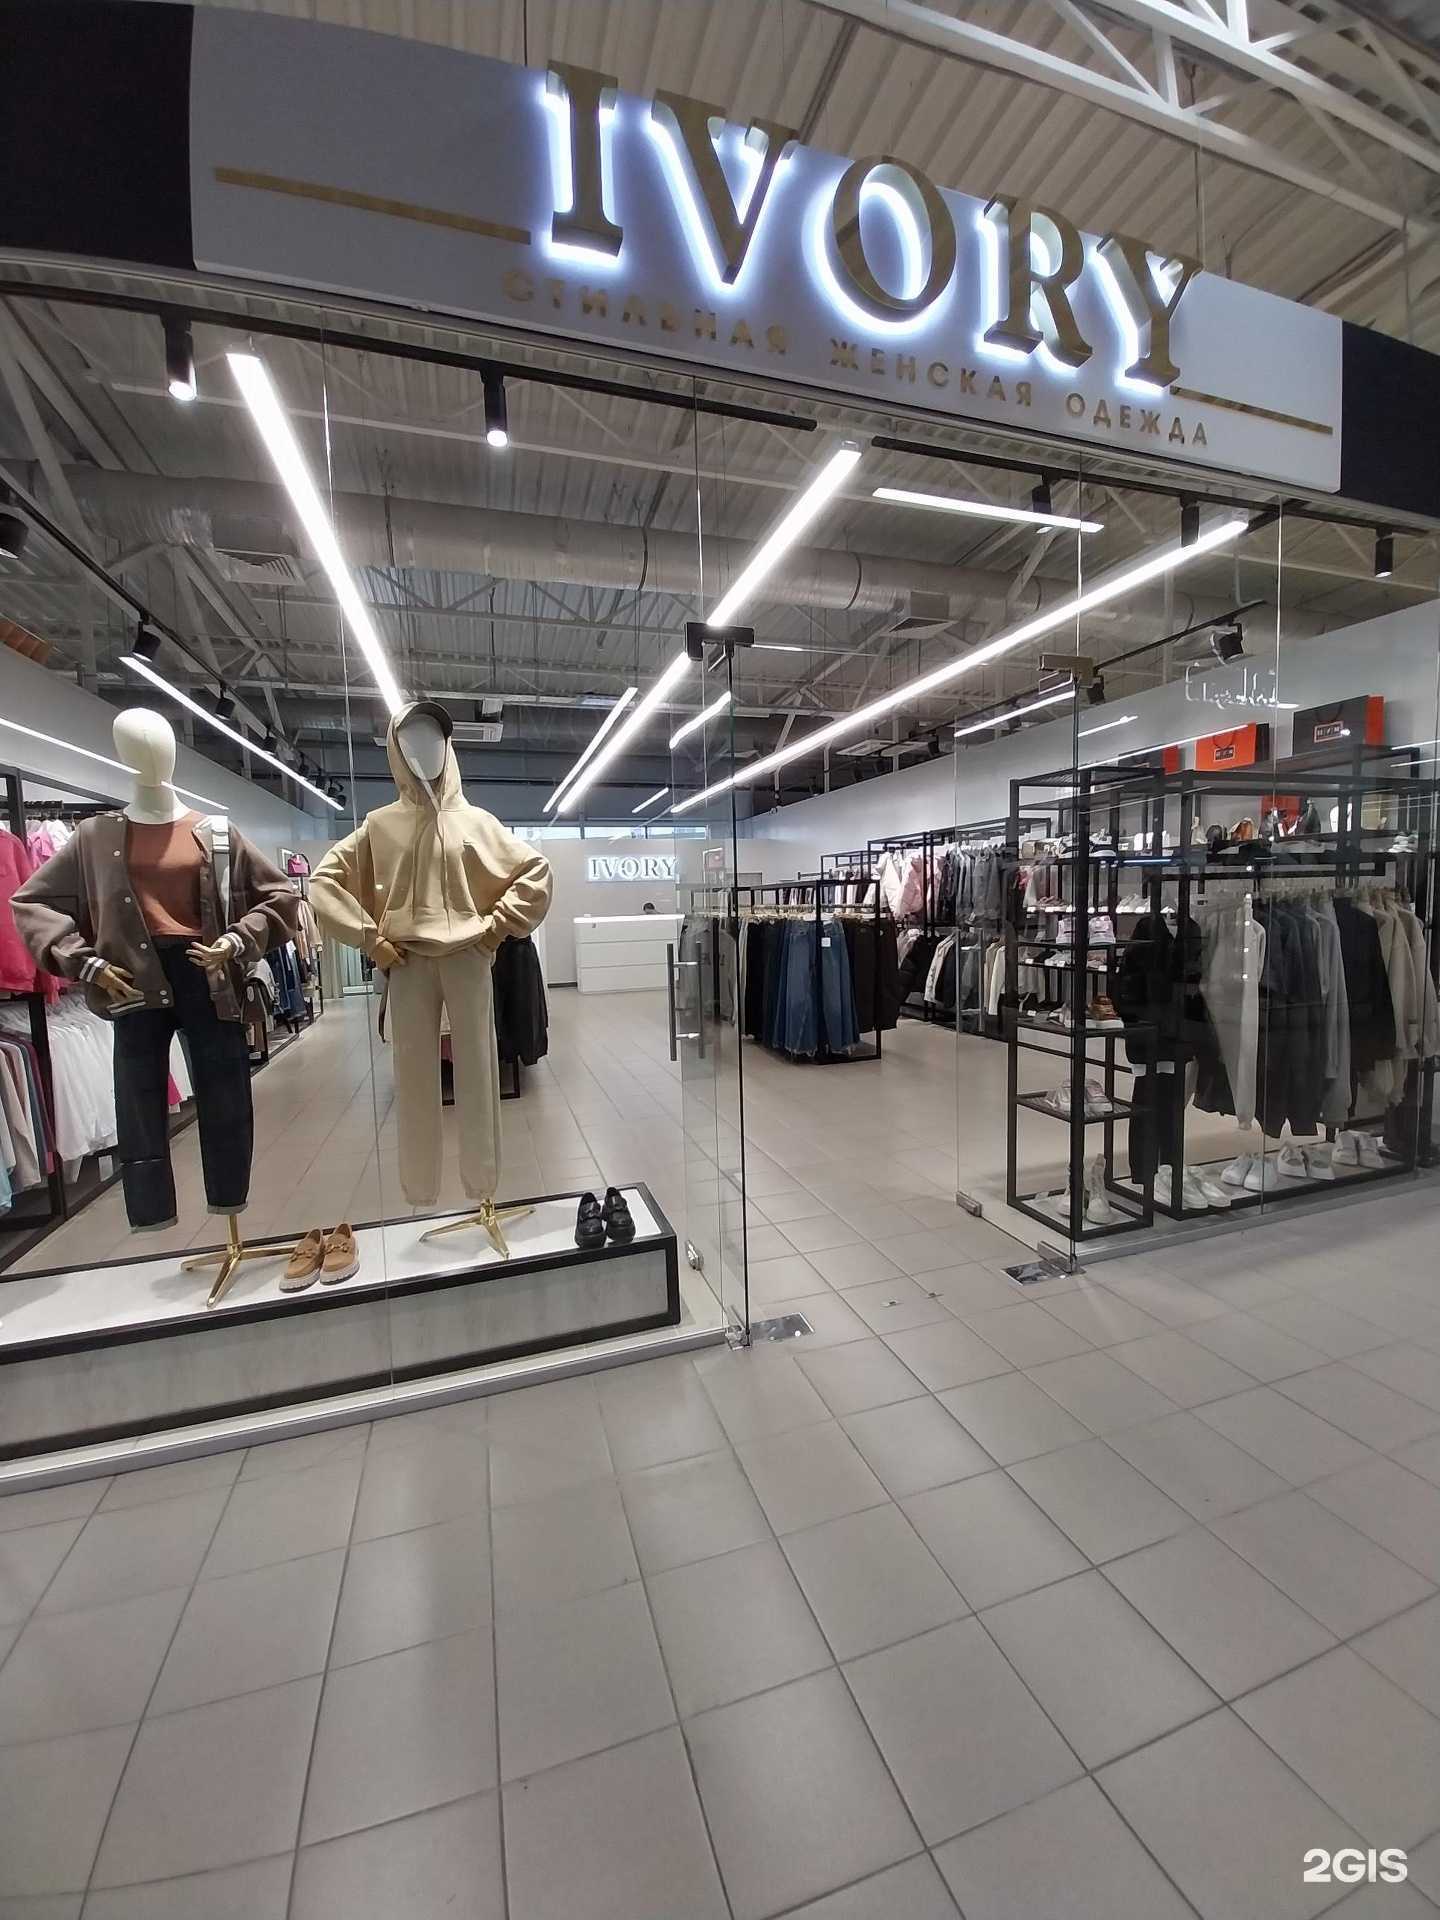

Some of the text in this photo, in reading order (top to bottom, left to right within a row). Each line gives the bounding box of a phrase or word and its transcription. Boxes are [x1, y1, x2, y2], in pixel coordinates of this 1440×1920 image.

[543, 60, 1204, 388] IVORY
[503, 270, 1208, 446] СТИЛЬНАЯ ЖЕНСКАЯ ОДЕЖДА
[590, 857, 678, 879] IVORY
